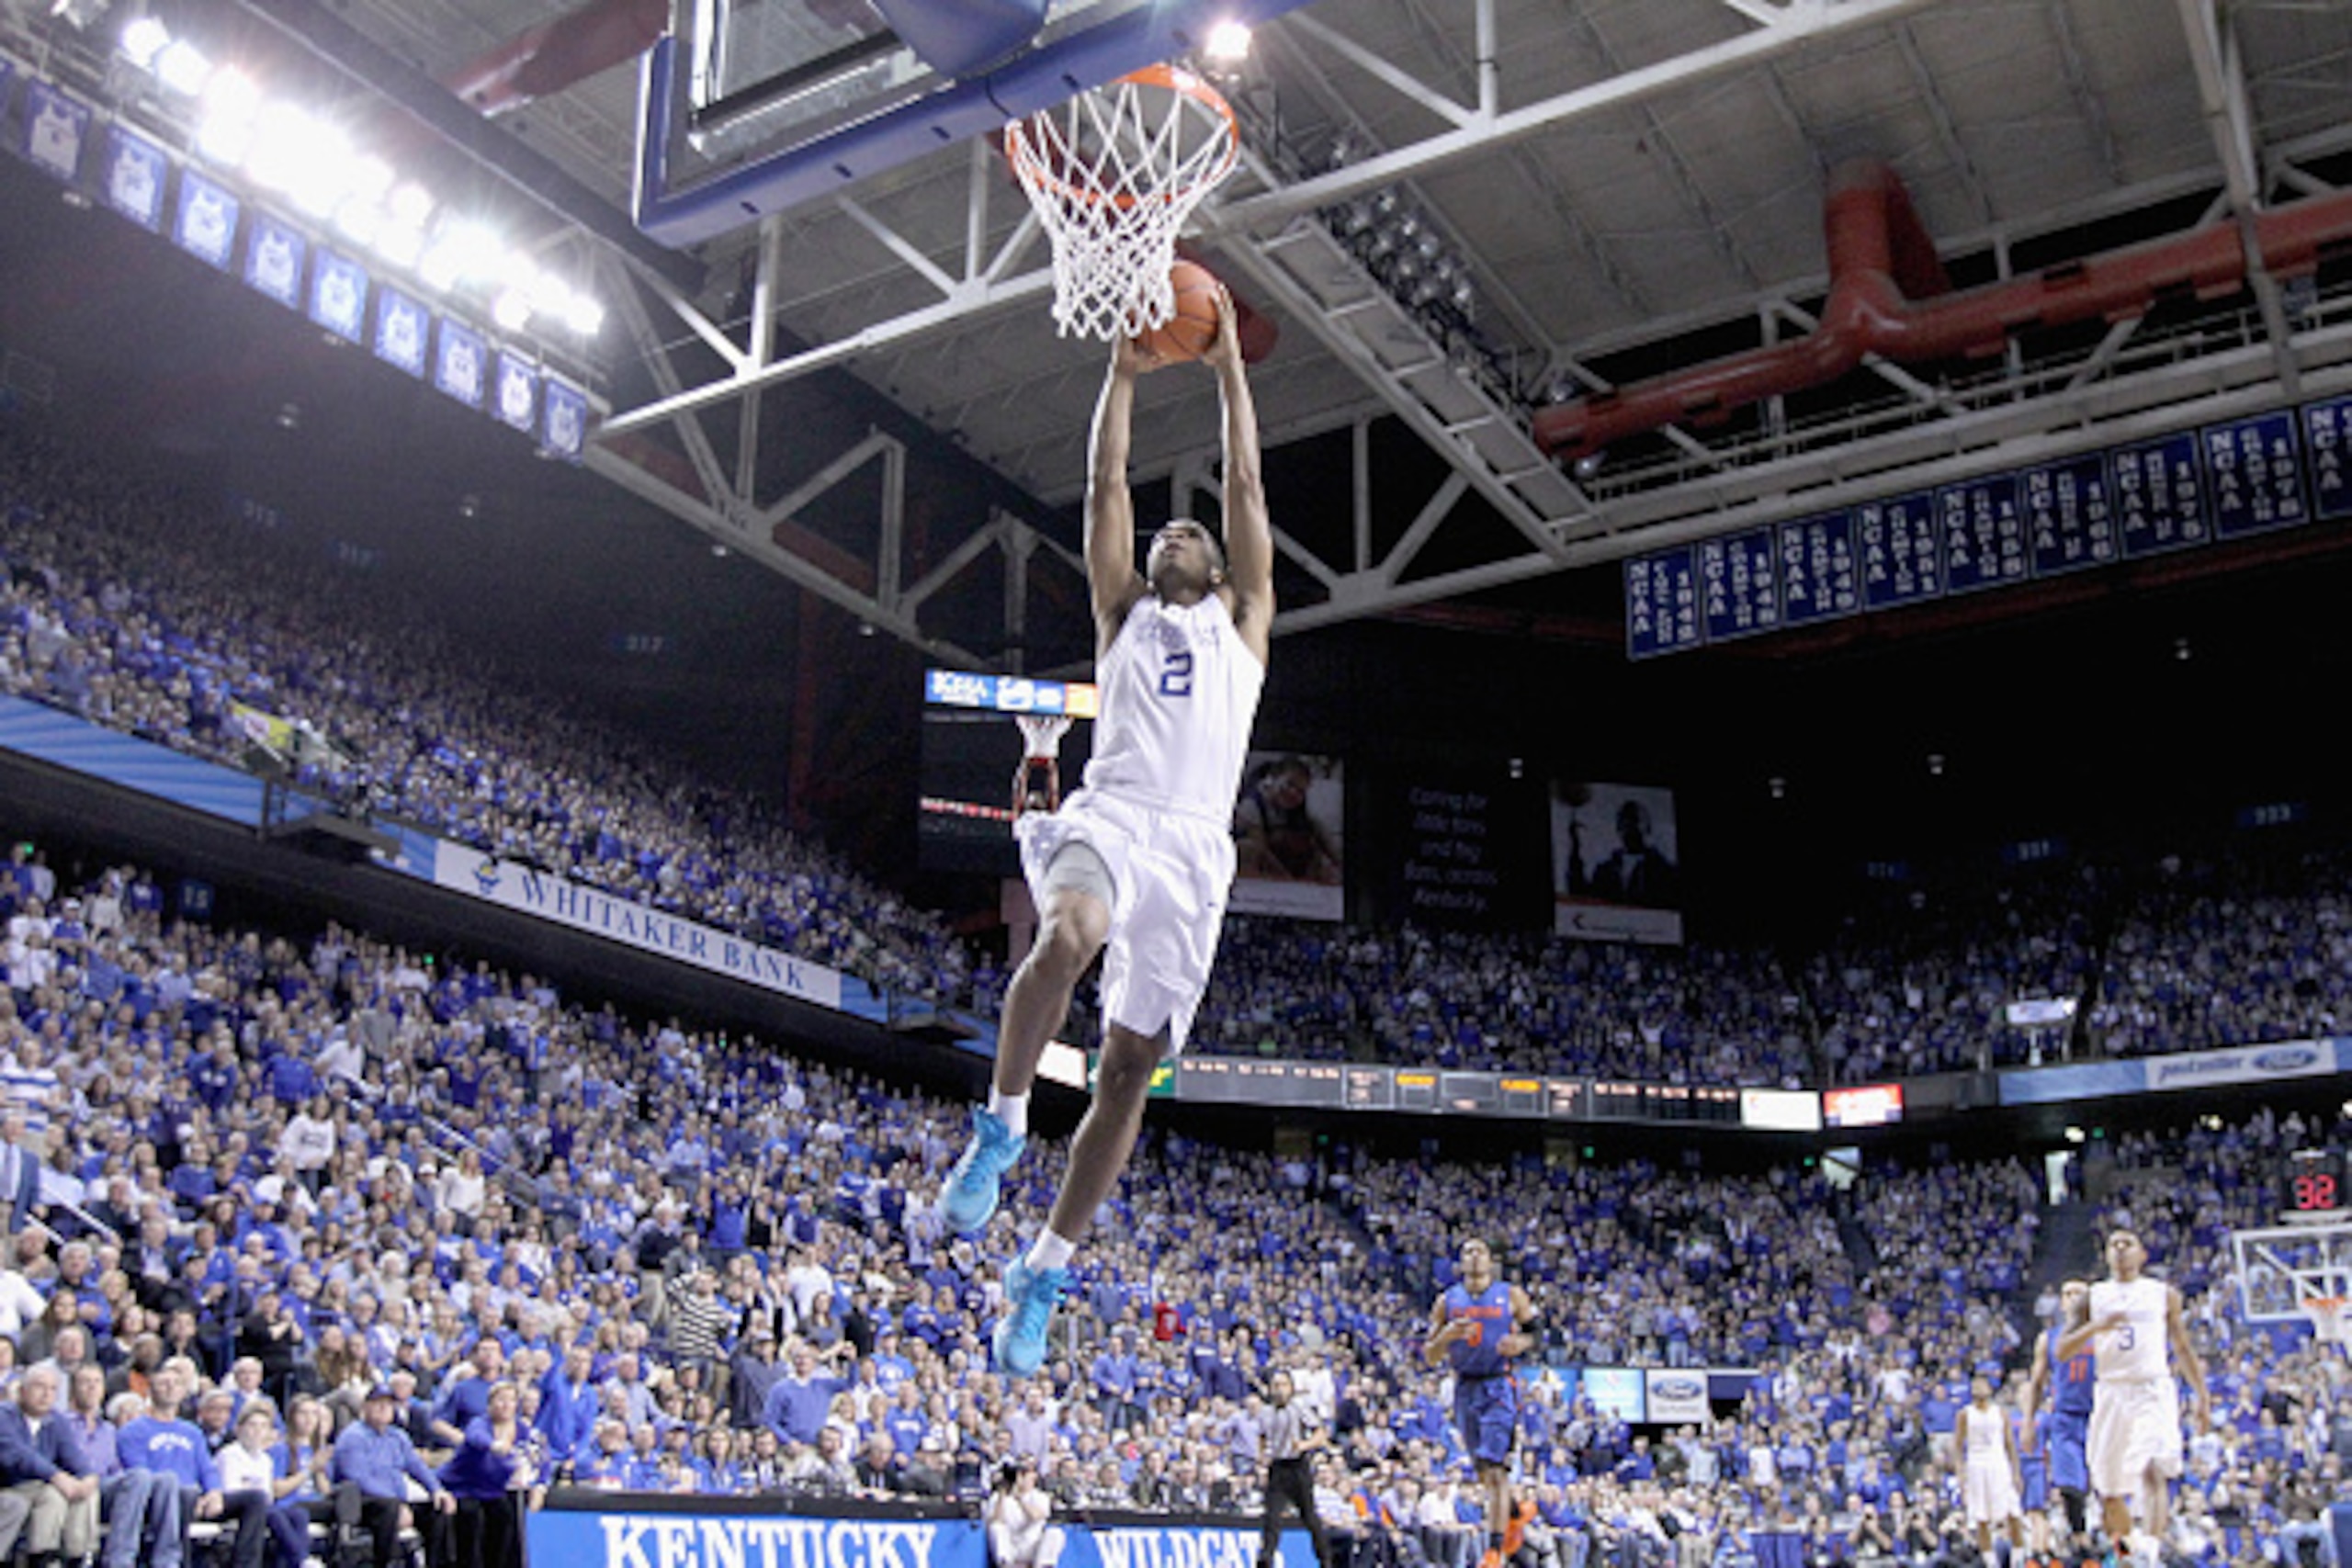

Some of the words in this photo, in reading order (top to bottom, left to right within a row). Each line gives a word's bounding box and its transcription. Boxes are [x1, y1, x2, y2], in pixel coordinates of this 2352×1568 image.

[2211, 430, 2242, 512] NCAA
[2311, 408, 2342, 490] NCAA
[2030, 471, 2055, 548] NCAA
[2117, 451, 2145, 532] NCAA
[1784, 526, 1806, 600] NCAA
[1863, 507, 1886, 583] NCAA
[1945, 491, 1970, 568] NCAA
[1630, 561, 1650, 634] NCAA
[1704, 544, 1725, 615] NCAA
[1159, 651, 1193, 696] 2
[522, 875, 707, 959] WHITAKER
[723, 942, 805, 989] BANK
[2296, 1174, 2335, 1210] 32
[2069, 1359, 2087, 1382] 11
[2118, 1325, 2134, 1350] 3
[600, 1516, 935, 1568] KENTUCKY
